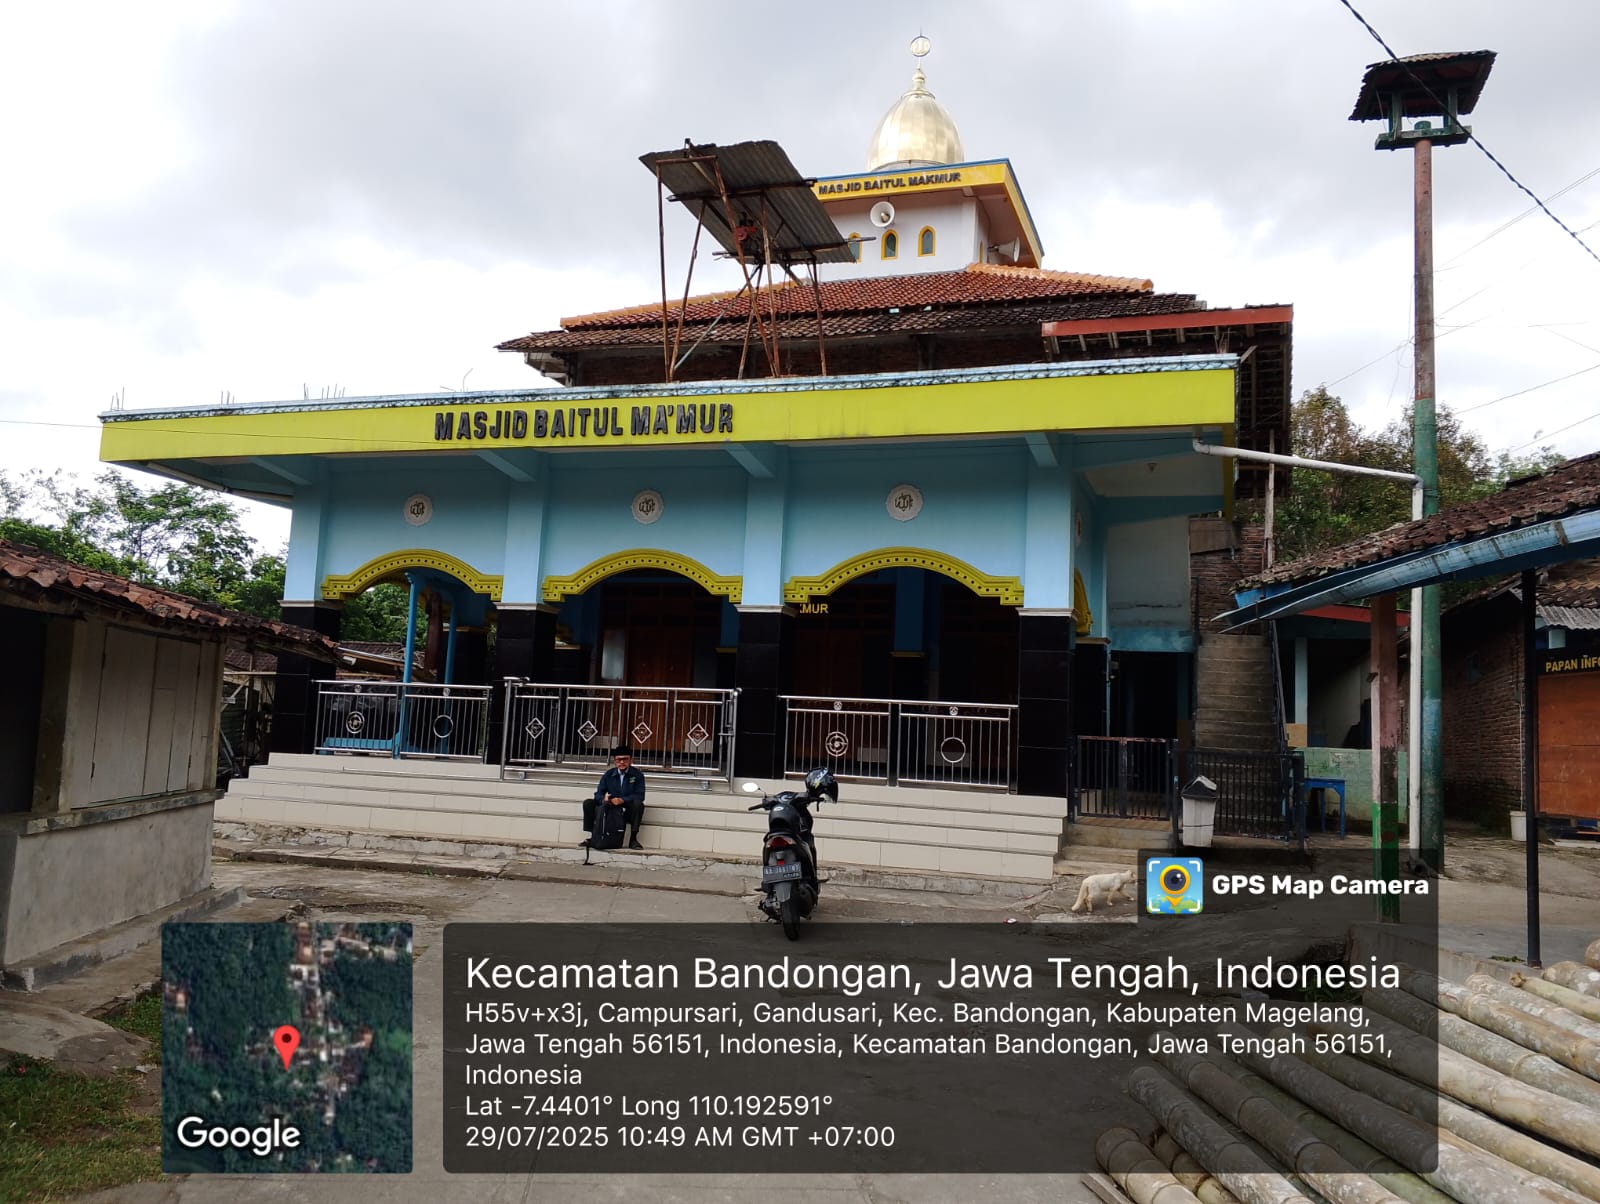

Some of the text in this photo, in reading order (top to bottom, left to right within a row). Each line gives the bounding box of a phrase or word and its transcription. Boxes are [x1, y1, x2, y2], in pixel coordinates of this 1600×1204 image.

[818, 172, 961, 195] MASJID BAITUL MAKMUR
[434, 403, 734, 441] MASJID BAITUL MA'MUR
[1545, 659, 1578, 673] PAPAN
